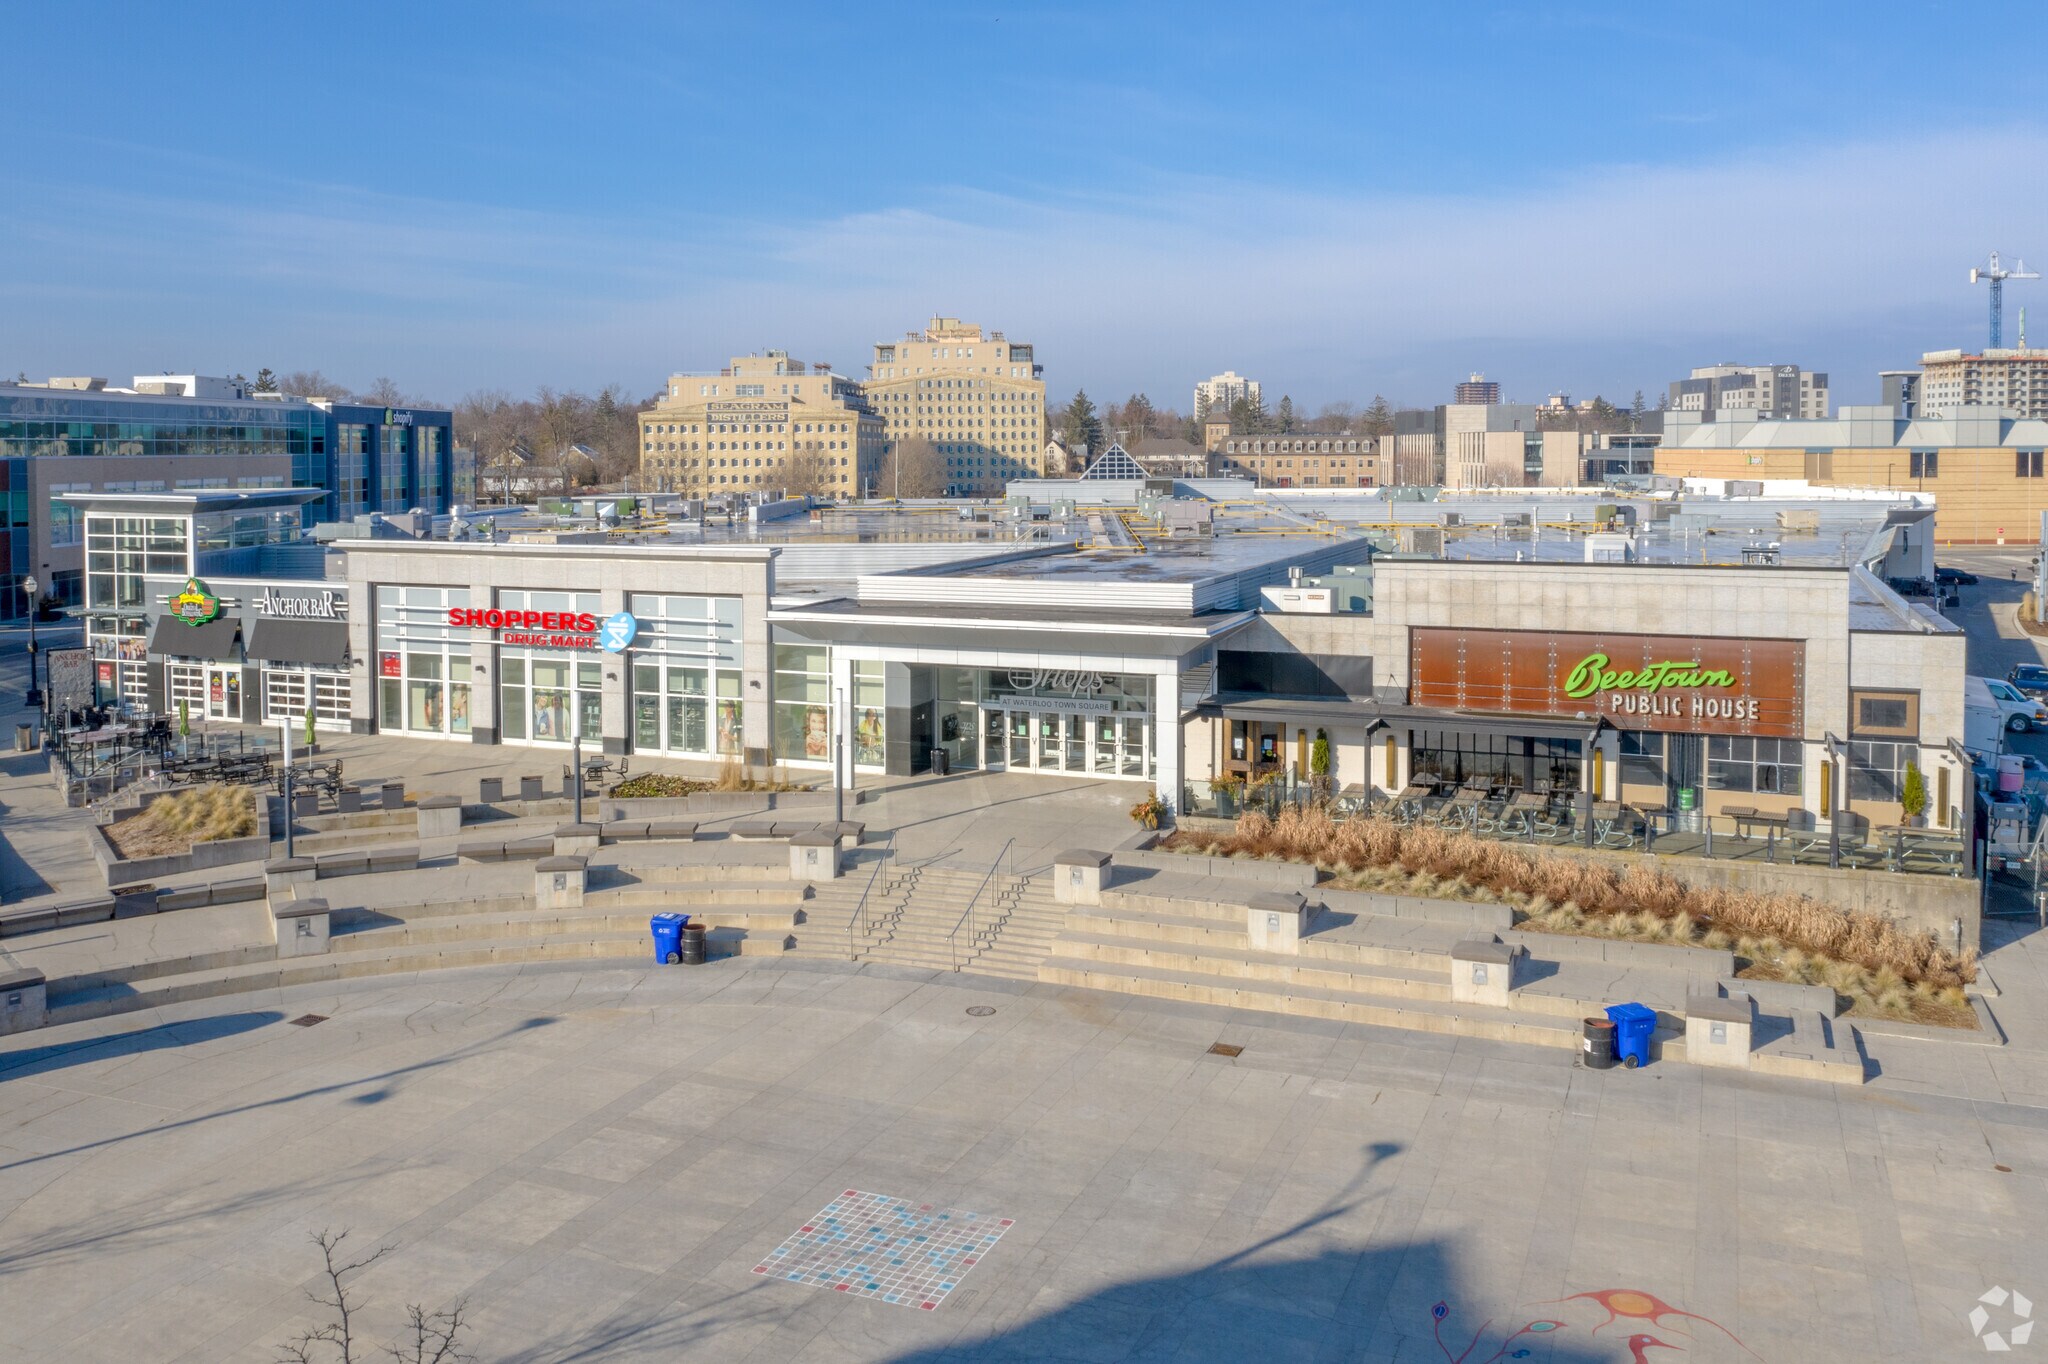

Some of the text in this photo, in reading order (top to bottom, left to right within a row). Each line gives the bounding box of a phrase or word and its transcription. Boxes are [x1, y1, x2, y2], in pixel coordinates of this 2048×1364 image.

[393, 411, 413, 426] shopify
[448, 607, 596, 633] SHOPPERS
[504, 633, 595, 648] DRUG MART
[1564, 653, 1735, 698] Beertown
[1013, 699, 1053, 708] WATERLOO
[1054, 701, 1077, 709] TOWN
[1078, 702, 1109, 711] SQUARE
[1612, 693, 1759, 720] PUBLIC HOUSE
